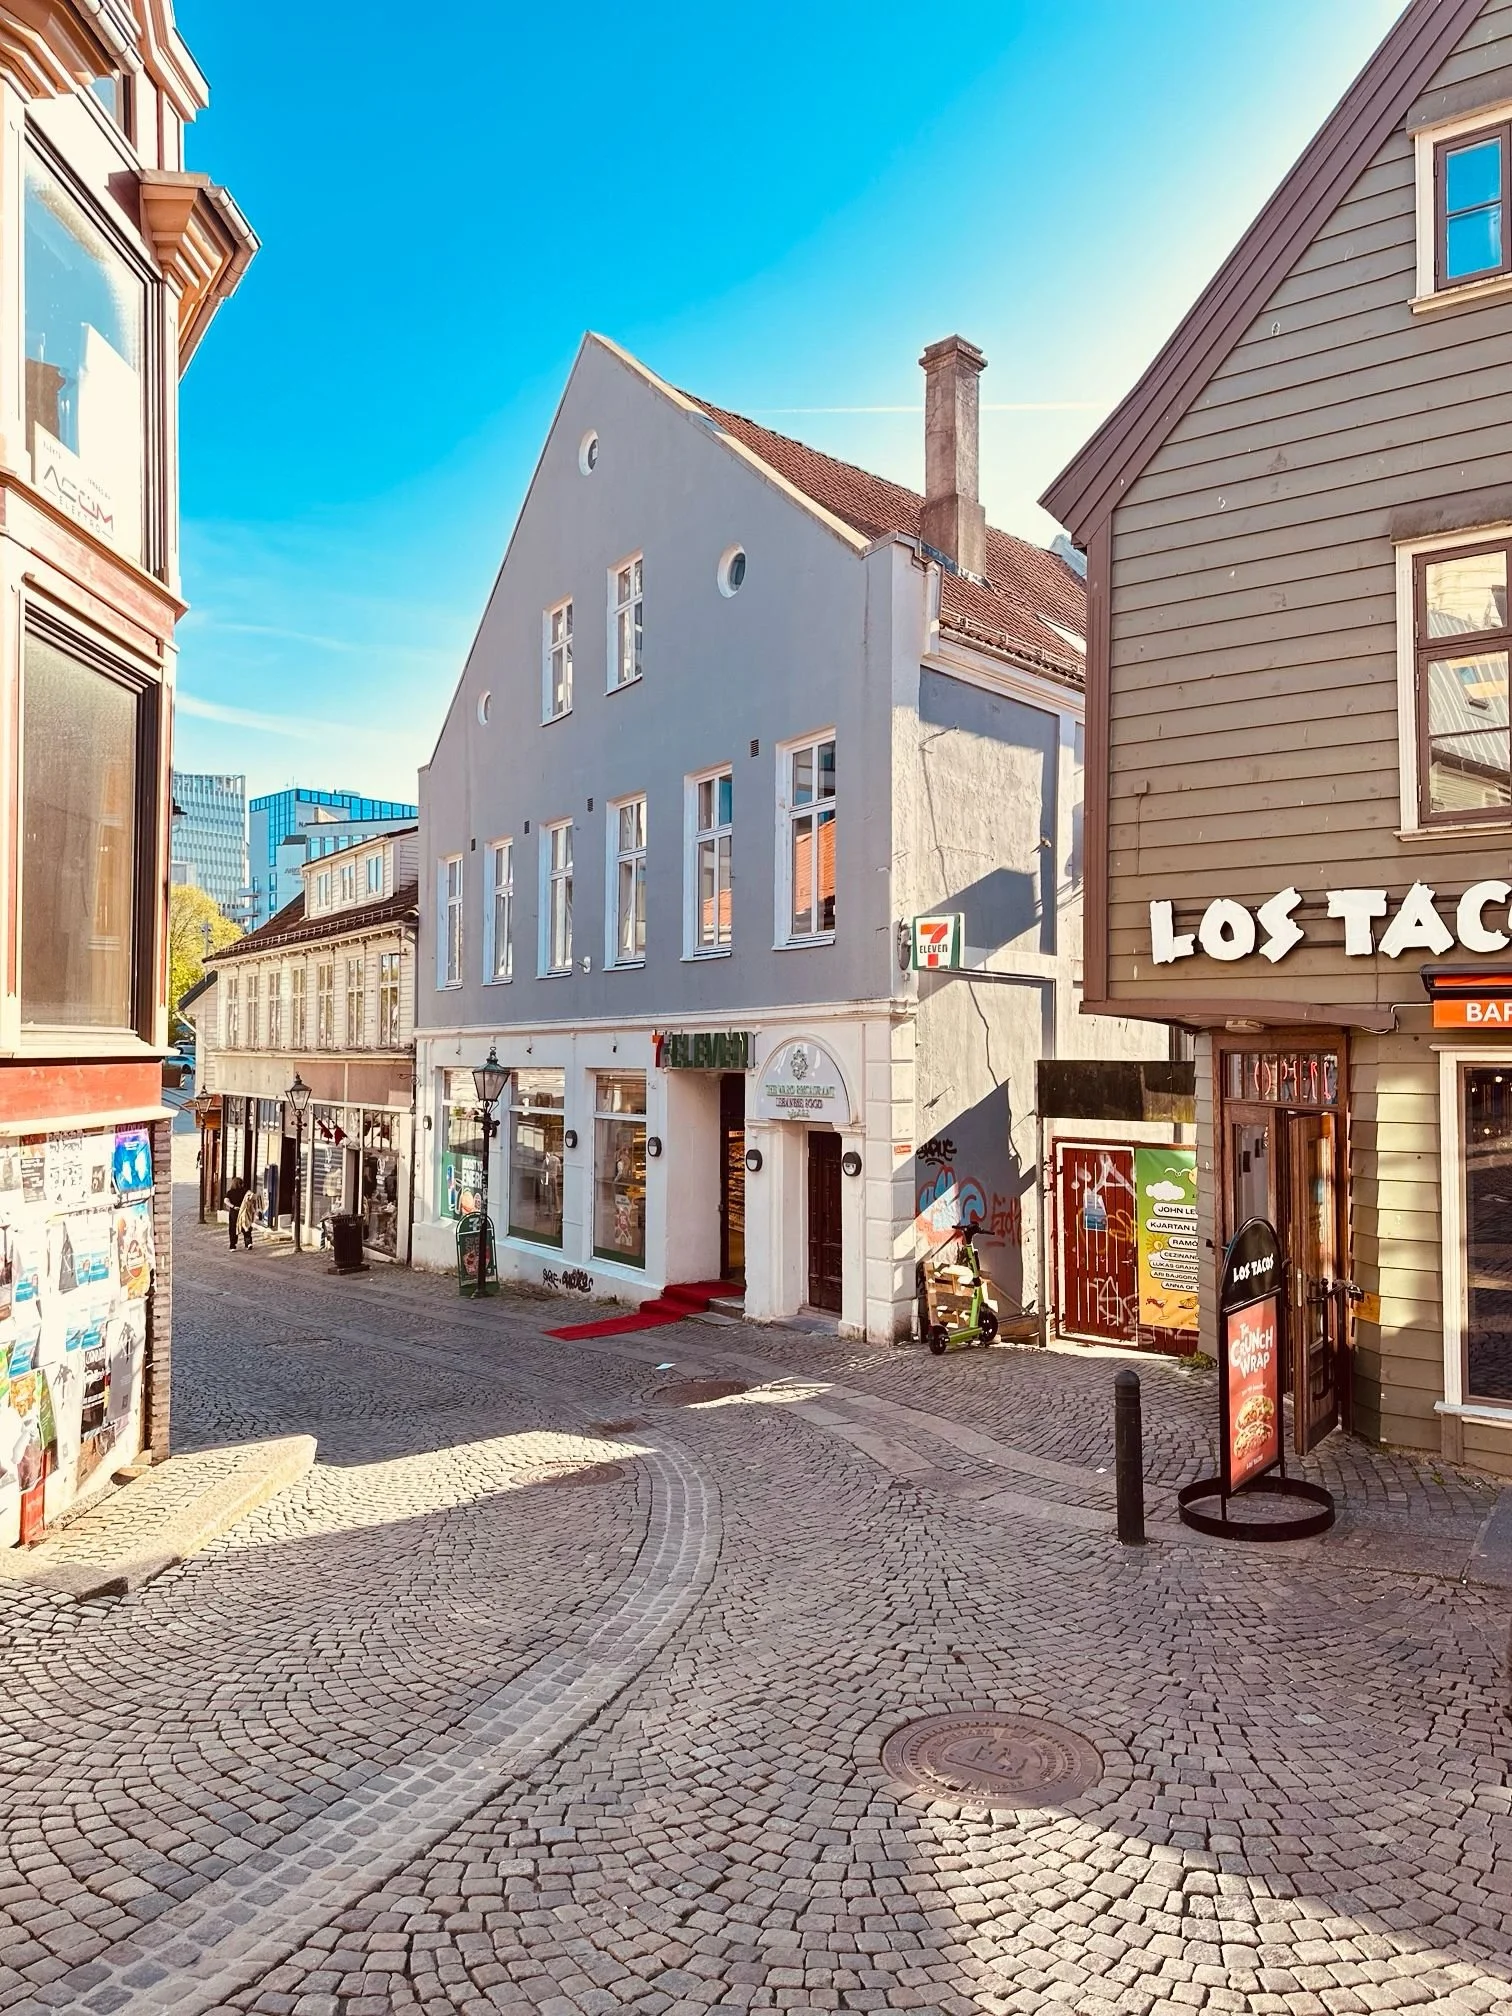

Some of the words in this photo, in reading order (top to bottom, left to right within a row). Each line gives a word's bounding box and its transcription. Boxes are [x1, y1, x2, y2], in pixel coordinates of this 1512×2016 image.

[1149, 886, 1305, 965] LOS
[1325, 879, 1512, 960] TAC
[920, 923, 949, 967] 7
[804, 1098, 824, 1110] FOOD
[1158, 1206, 1184, 1214] JOHN
[1150, 1221, 1190, 1231] KJARTAN
[1233, 1262, 1250, 1283] LOS
[1250, 1253, 1274, 1277] TACOS
[1230, 1325, 1274, 1368] CRUNCH
[1240, 1351, 1270, 1379] WRAP
